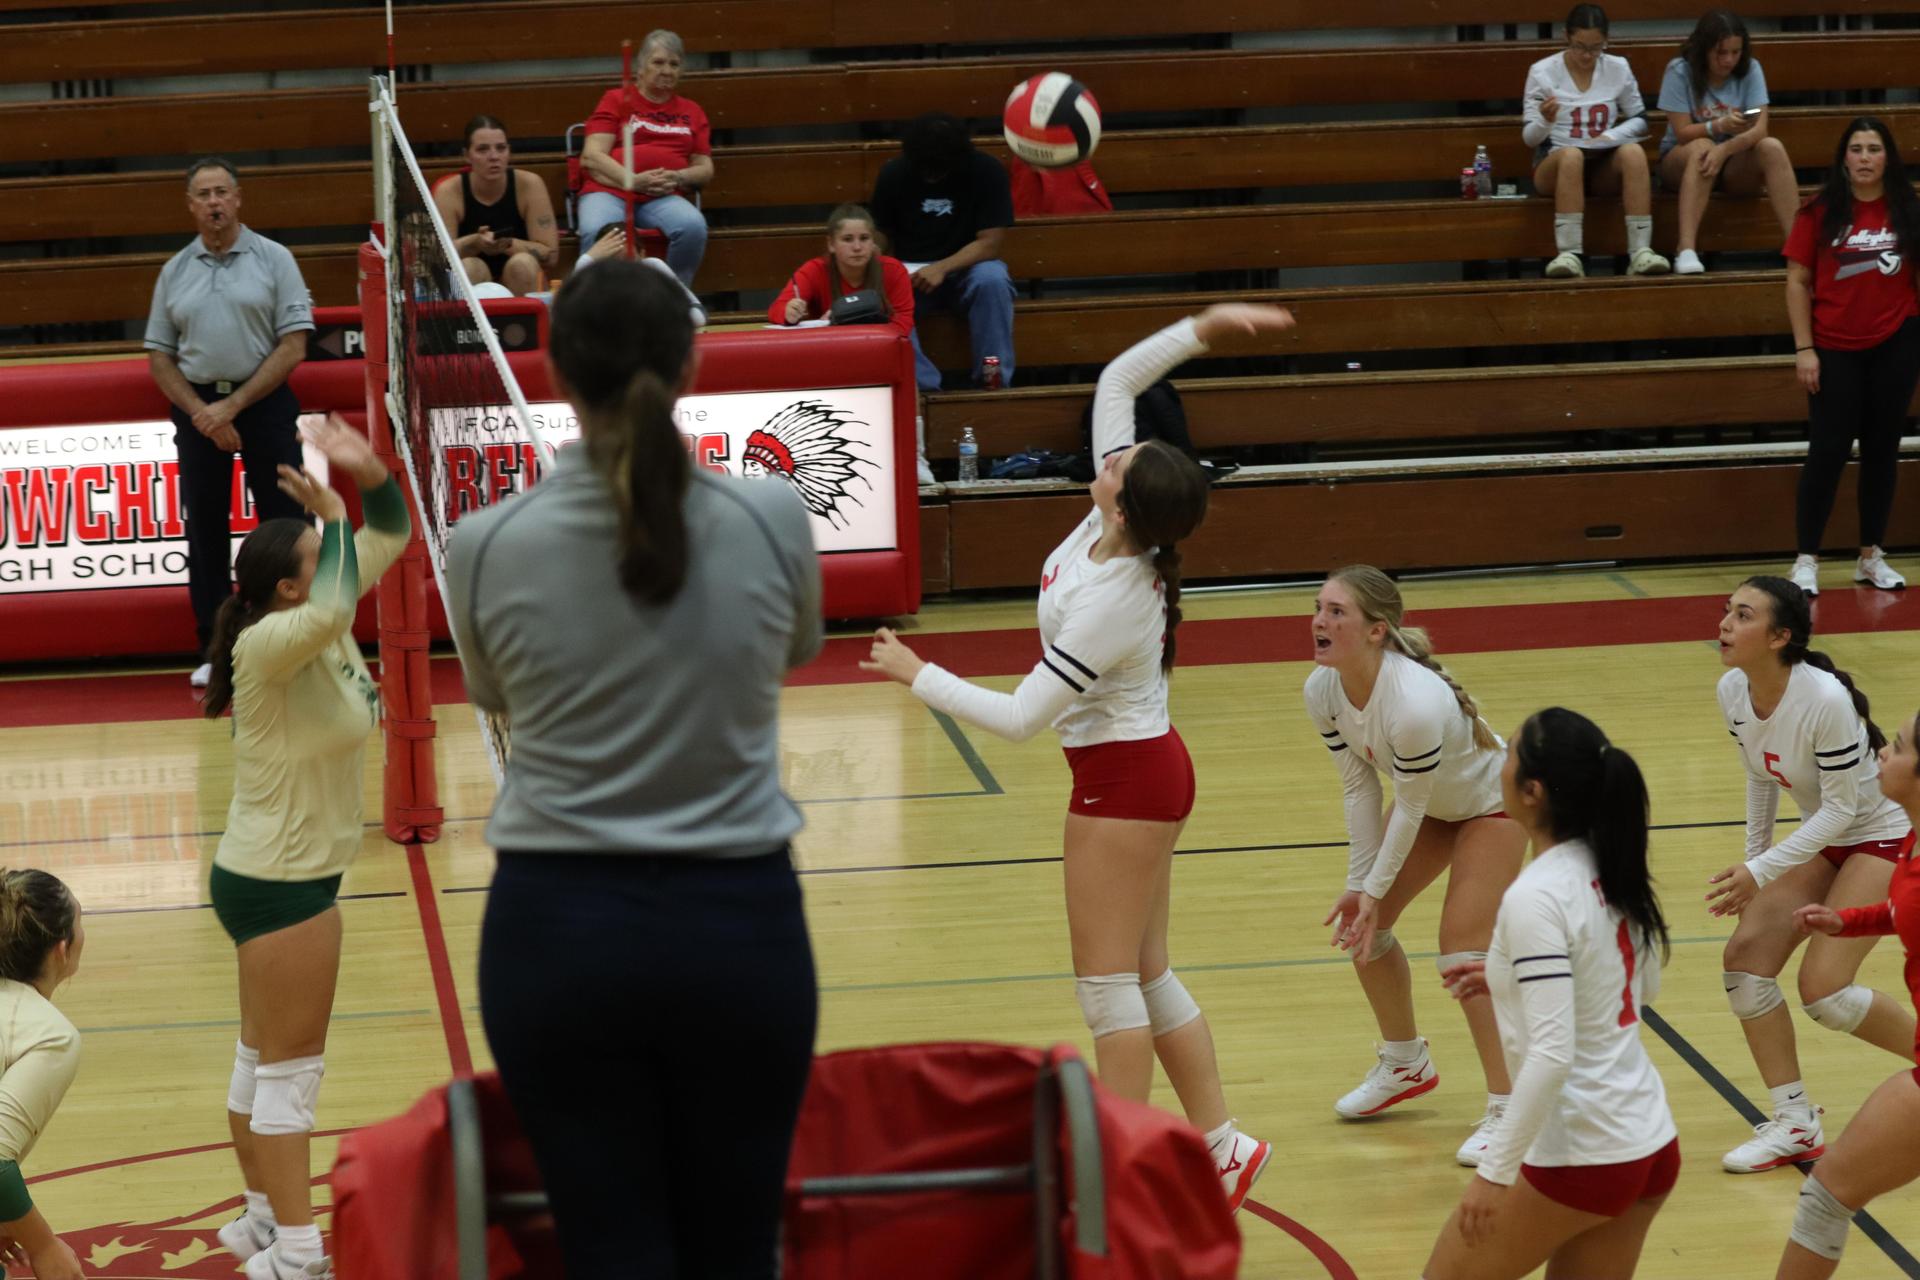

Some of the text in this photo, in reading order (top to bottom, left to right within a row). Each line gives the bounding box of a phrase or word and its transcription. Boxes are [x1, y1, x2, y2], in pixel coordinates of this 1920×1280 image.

[1569, 104, 1609, 138] 10
[465, 408, 708, 432] FCA Sup he
[0, 433, 141, 455] WELCOME
[73, 552, 189, 579] SCHO
[1763, 751, 1792, 788] 5
